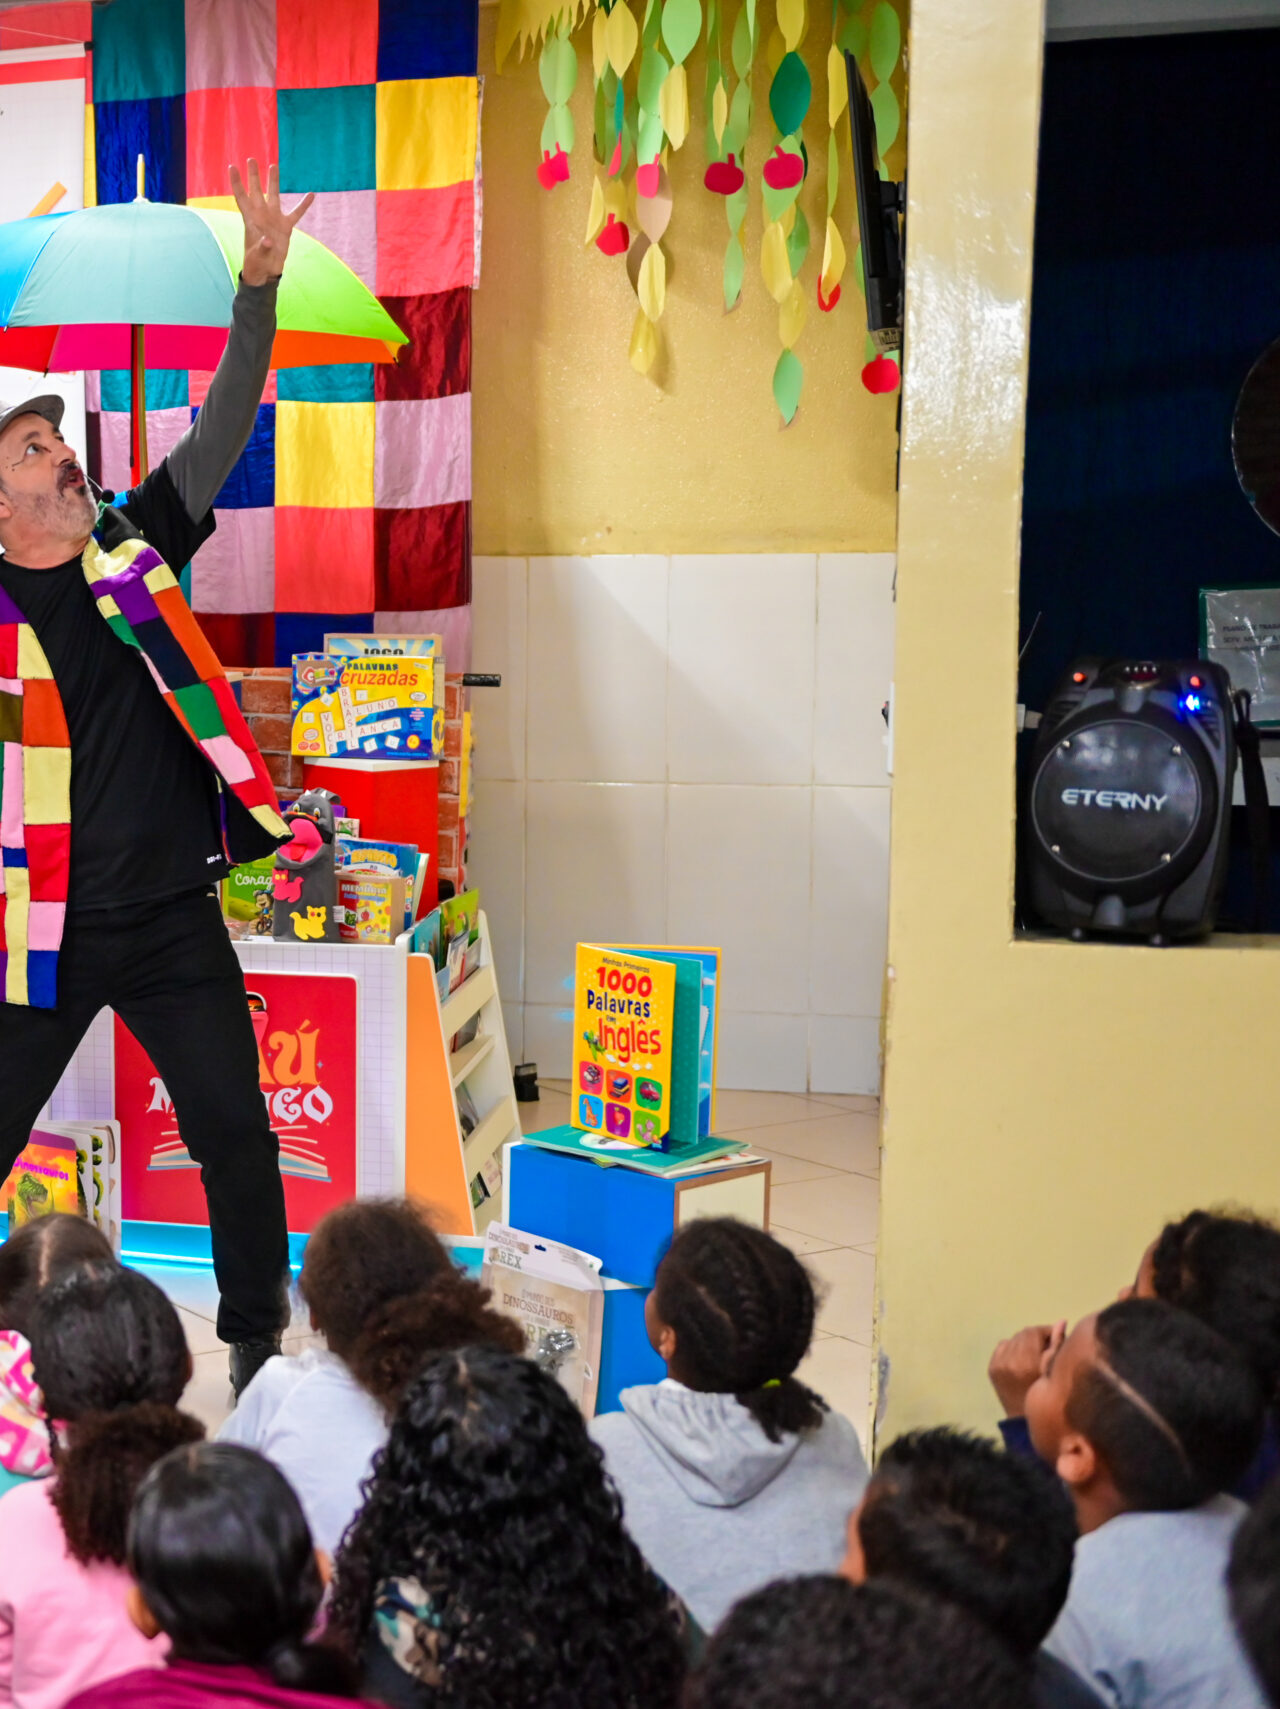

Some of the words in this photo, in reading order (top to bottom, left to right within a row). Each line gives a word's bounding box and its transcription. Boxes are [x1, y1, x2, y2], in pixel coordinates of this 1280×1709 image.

[339, 669, 419, 687] cruzadas
[347, 663, 399, 671] PALAVRAS
[1061, 788, 1168, 812] ETERNY
[235, 873, 273, 890] Corag
[596, 966, 653, 998] 1000
[587, 989, 651, 1018] Palavras
[598, 1017, 662, 1063] Inglês
[503, 1292, 574, 1325] DINOSSAUROS
